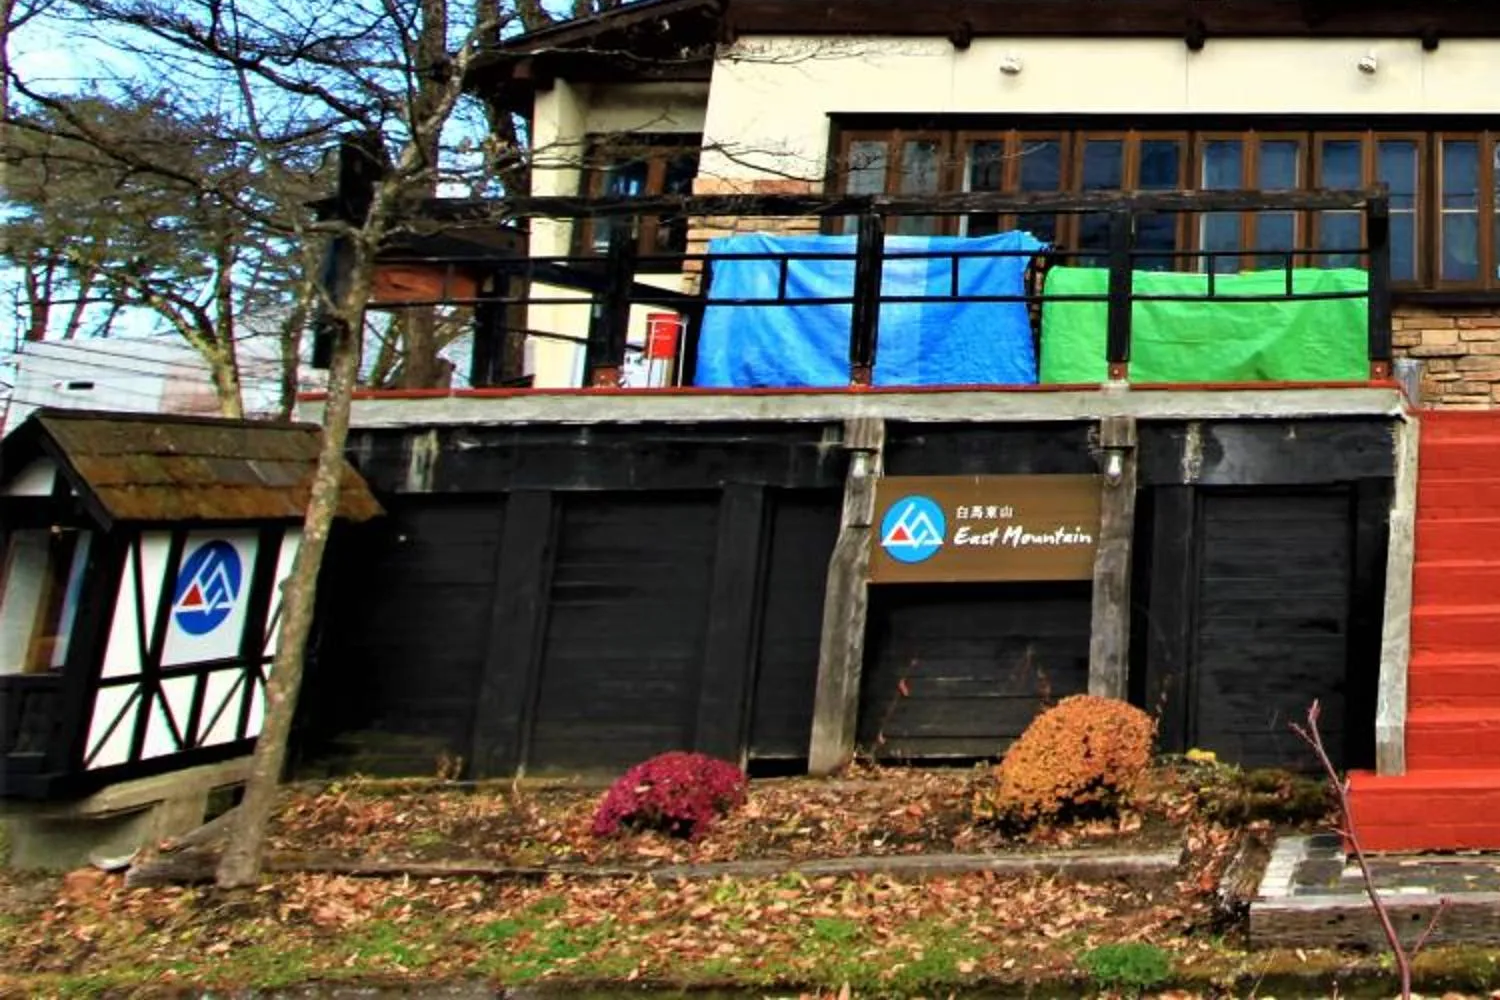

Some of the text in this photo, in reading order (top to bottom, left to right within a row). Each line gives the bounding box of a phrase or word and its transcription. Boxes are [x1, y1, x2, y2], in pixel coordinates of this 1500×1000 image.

[955, 505, 1014, 520] 白馬東山
[953, 524, 1093, 548] East Mountain
